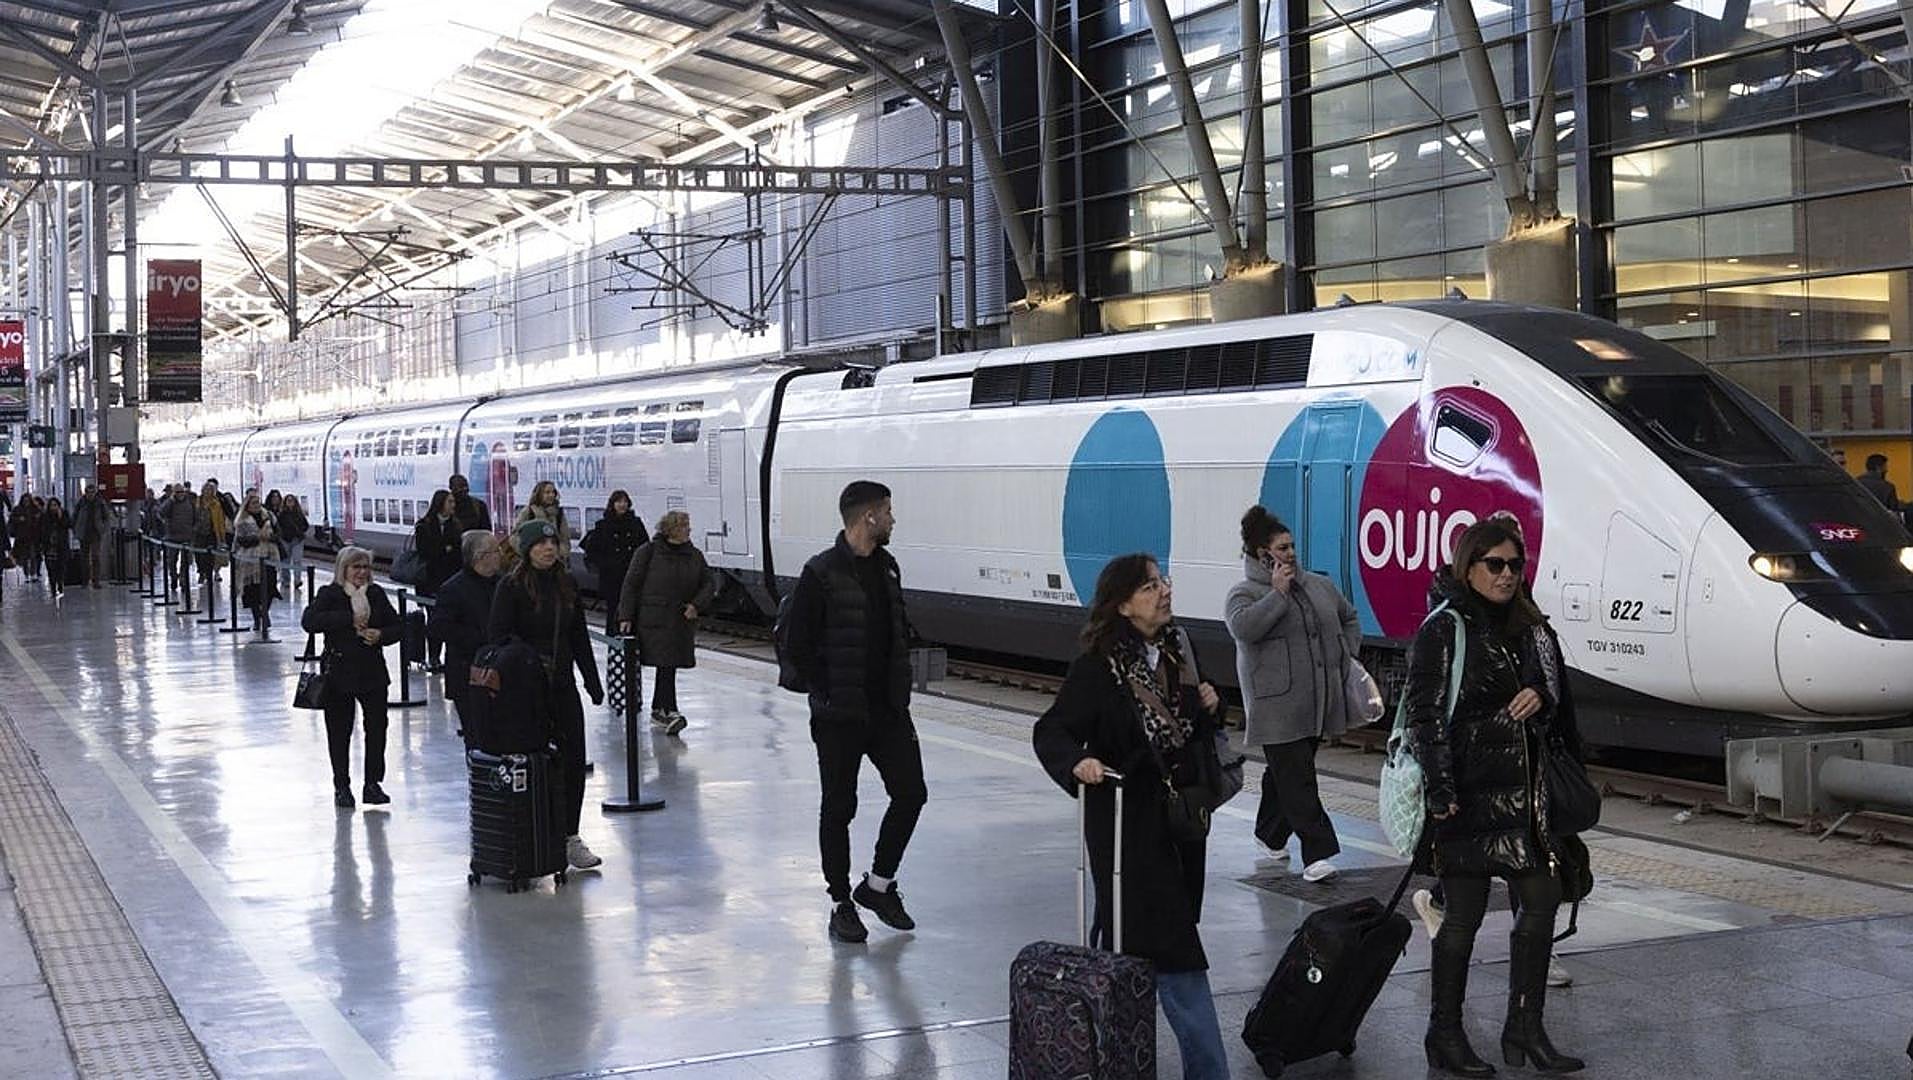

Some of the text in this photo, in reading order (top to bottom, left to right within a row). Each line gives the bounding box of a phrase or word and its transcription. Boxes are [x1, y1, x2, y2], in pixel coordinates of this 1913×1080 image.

[148, 269, 200, 298] iryo
[1820, 528, 1860, 540] SNCF
[1610, 599, 1644, 621] 822
[1587, 639, 1646, 656] TGV 310243
